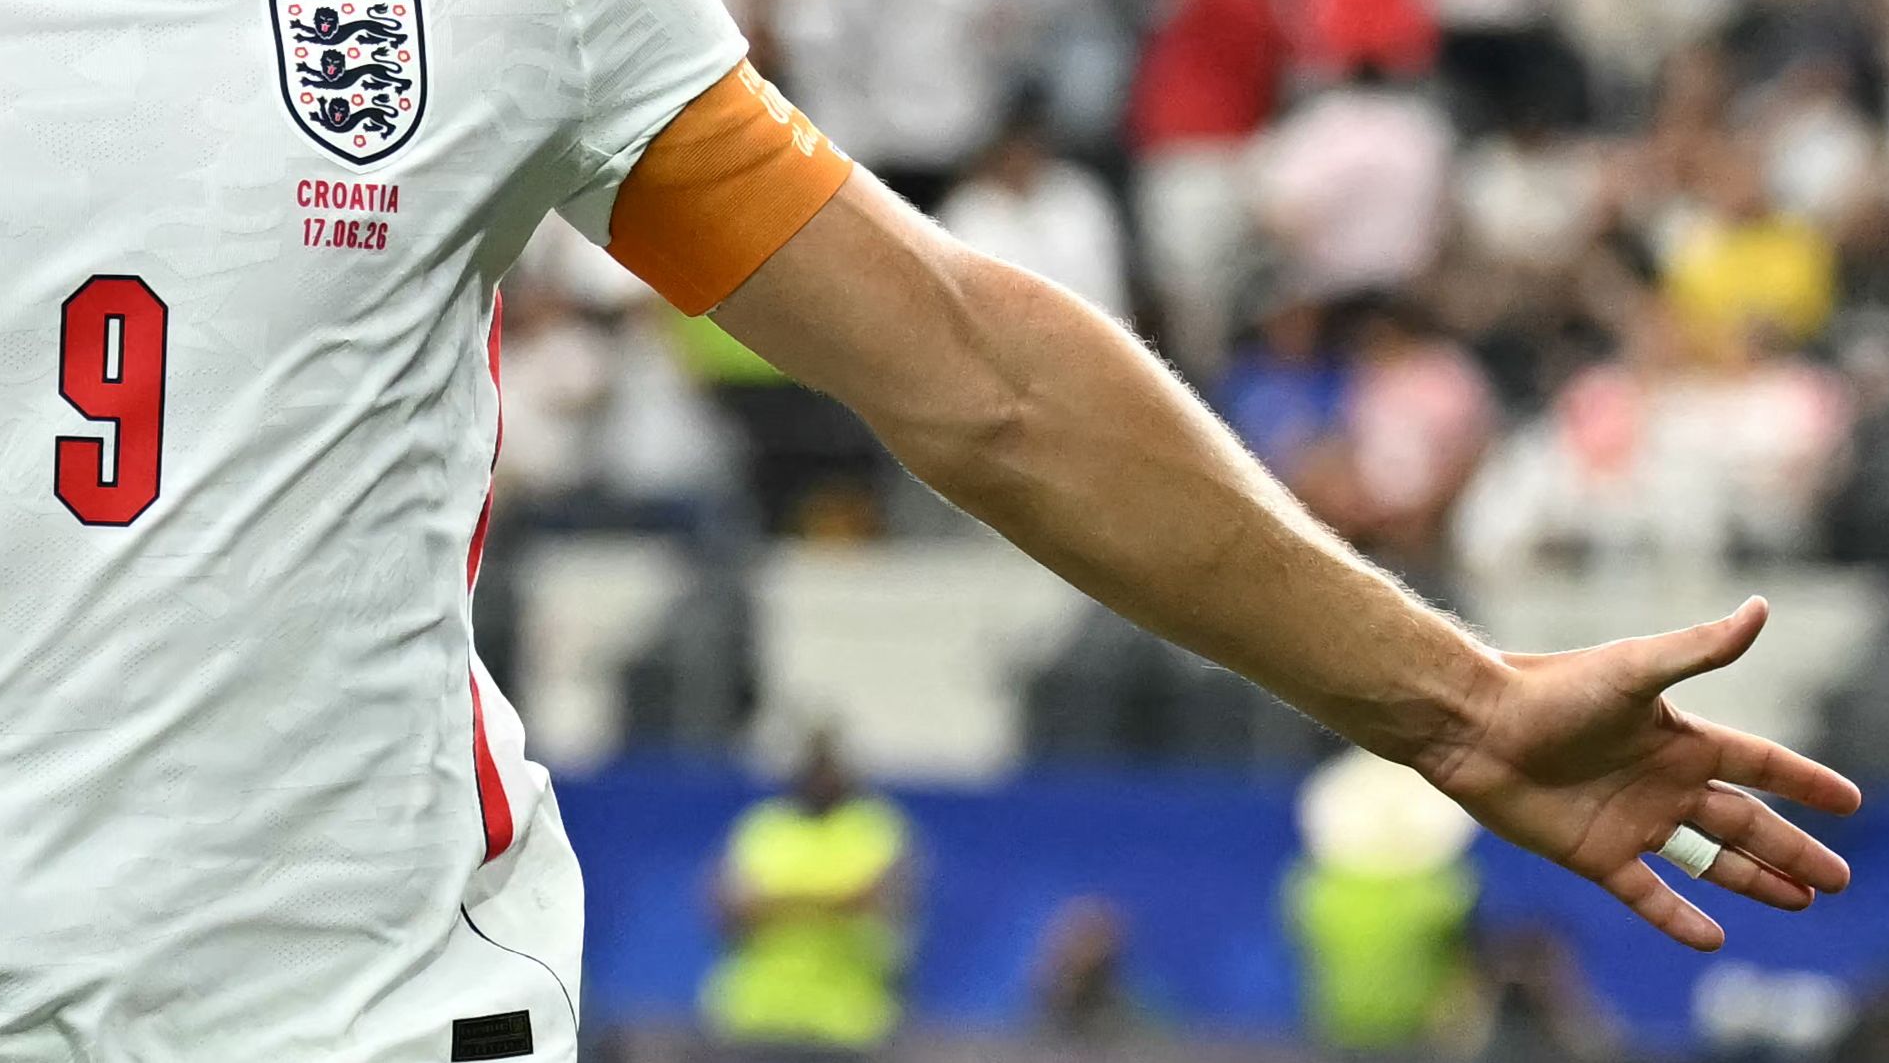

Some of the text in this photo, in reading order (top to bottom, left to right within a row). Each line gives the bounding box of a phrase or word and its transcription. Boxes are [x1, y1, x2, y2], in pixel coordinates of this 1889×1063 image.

[296, 179, 399, 213] CROATIA
[303, 218, 388, 250] 17.06.26
[54, 274, 168, 526] 9
